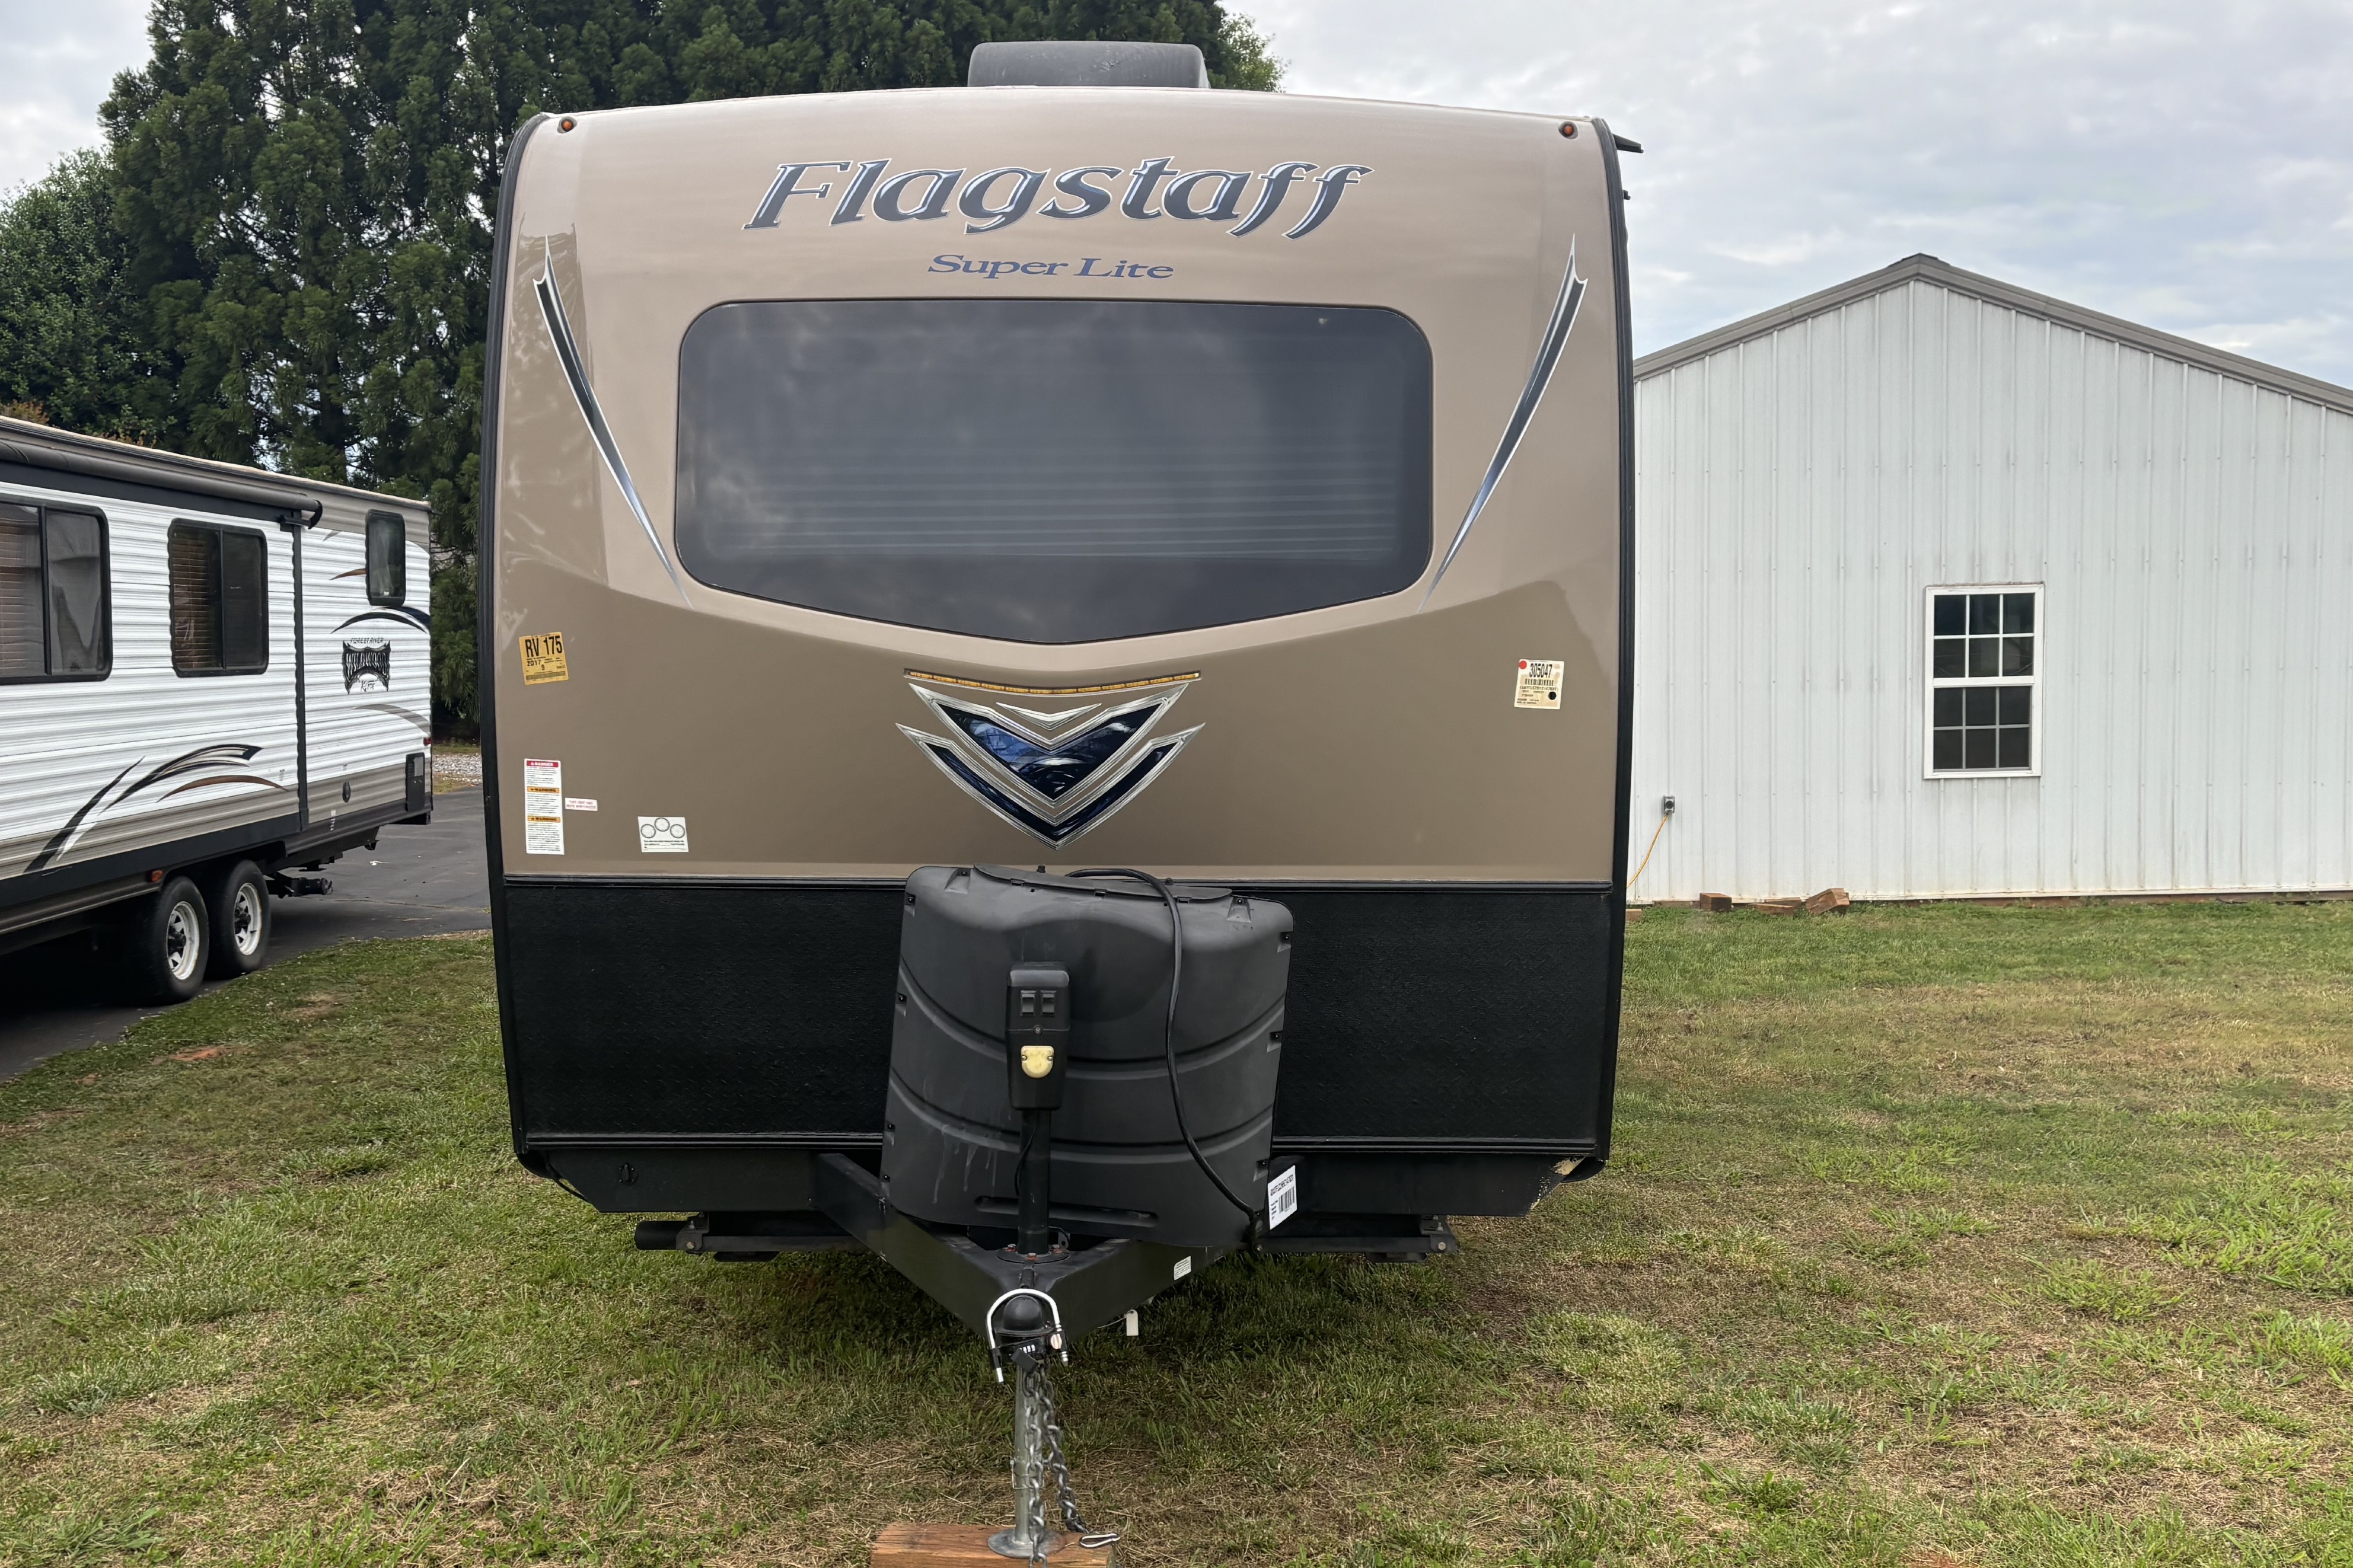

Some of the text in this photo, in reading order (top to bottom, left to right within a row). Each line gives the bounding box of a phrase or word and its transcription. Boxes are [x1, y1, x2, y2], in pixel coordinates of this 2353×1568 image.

[741, 156, 1375, 241] Flagstaff
[927, 254, 1174, 279] Super Lite
[525, 635, 563, 658] RV 175
[1529, 663, 1552, 678] 305047
